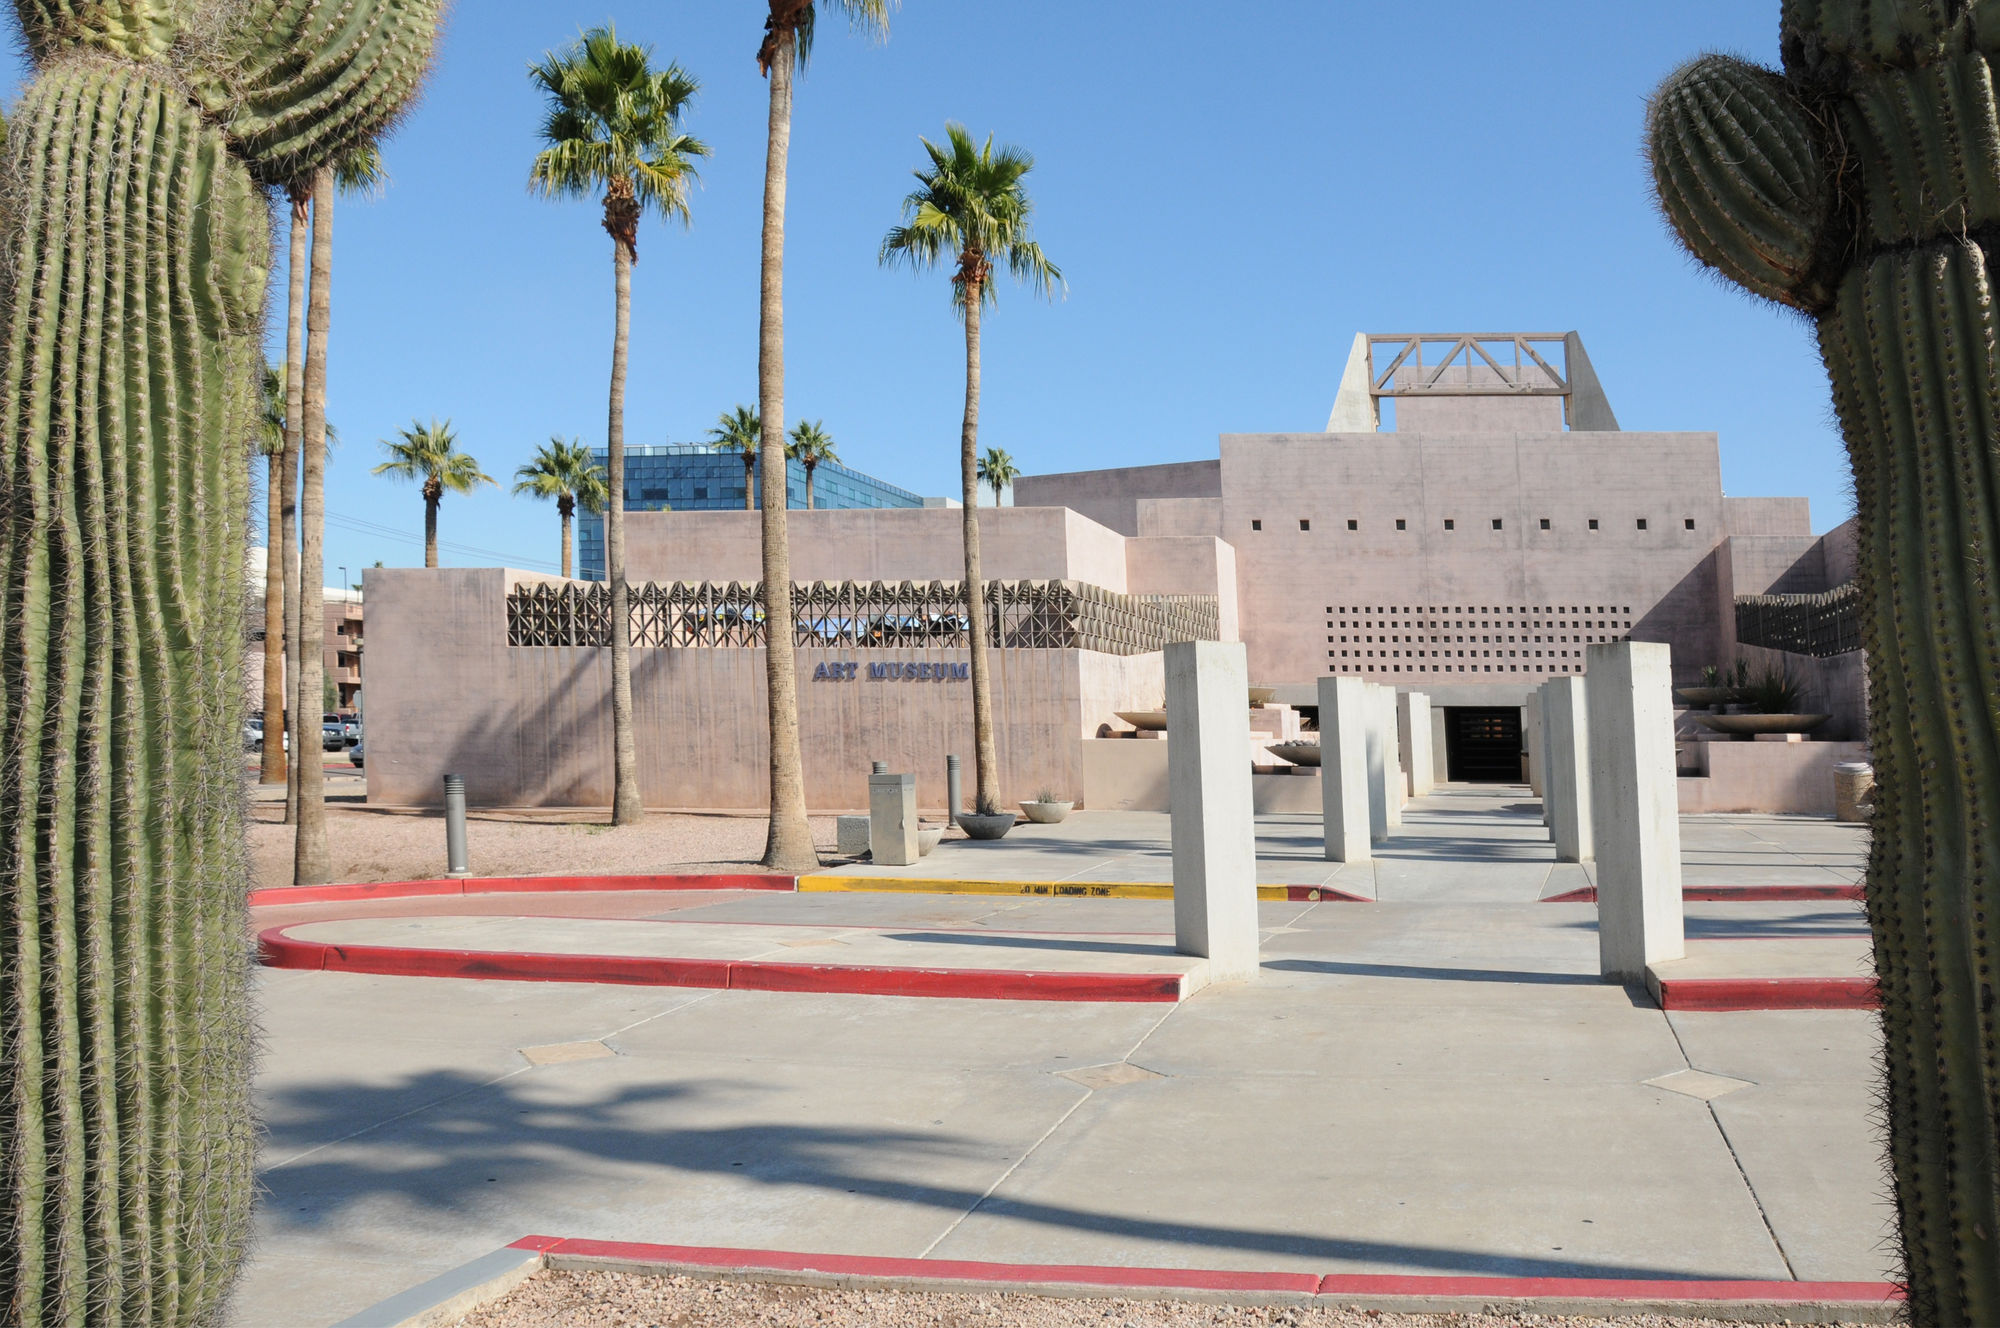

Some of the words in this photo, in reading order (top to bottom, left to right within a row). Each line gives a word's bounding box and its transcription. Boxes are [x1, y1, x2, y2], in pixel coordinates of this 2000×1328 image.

[815, 662, 858, 680] ART
[870, 662, 970, 680] MUSEUM
[1034, 885, 1048, 895] MIN
[1053, 886, 1087, 896] LOADING
[1091, 887, 1111, 896] ZONE
